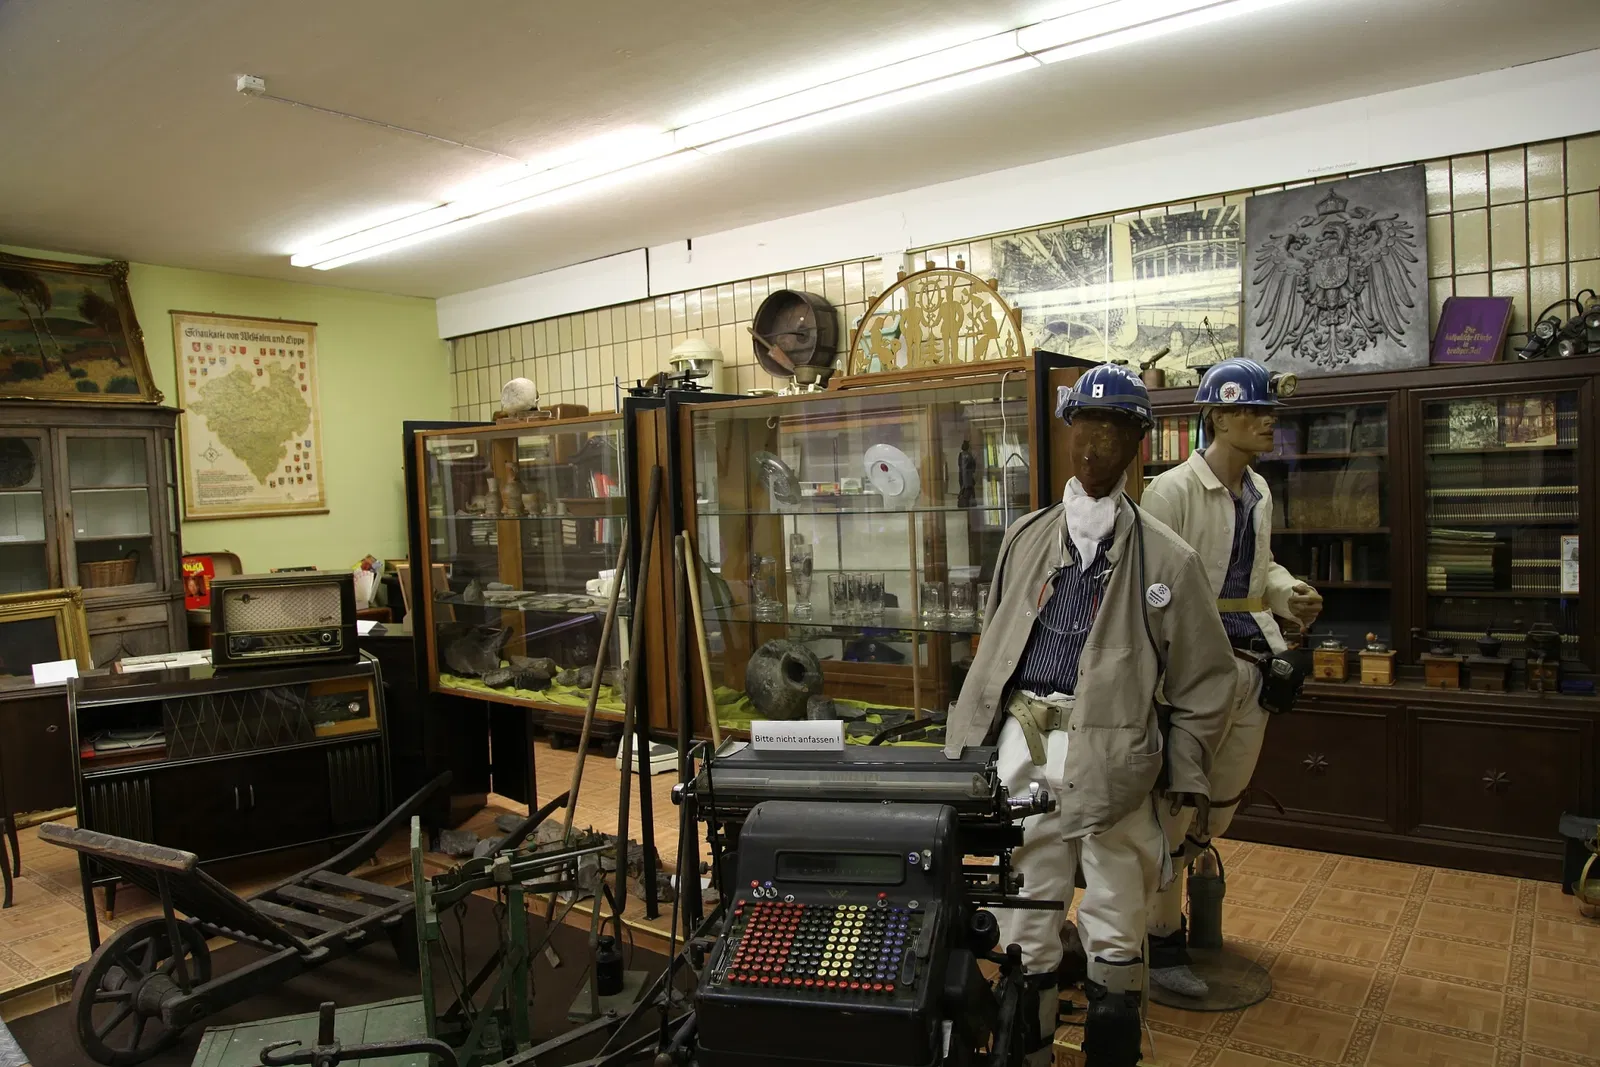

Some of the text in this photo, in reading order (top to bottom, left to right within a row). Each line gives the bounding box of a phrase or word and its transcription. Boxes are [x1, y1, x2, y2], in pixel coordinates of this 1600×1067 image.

[226, 331, 239, 340] von
[271, 335, 285, 344] und
[285, 335, 305, 345] Lippe
[755, 735, 774, 743] Bitte
[776, 735, 796, 743] nicht
[798, 735, 834, 744] anfassen
